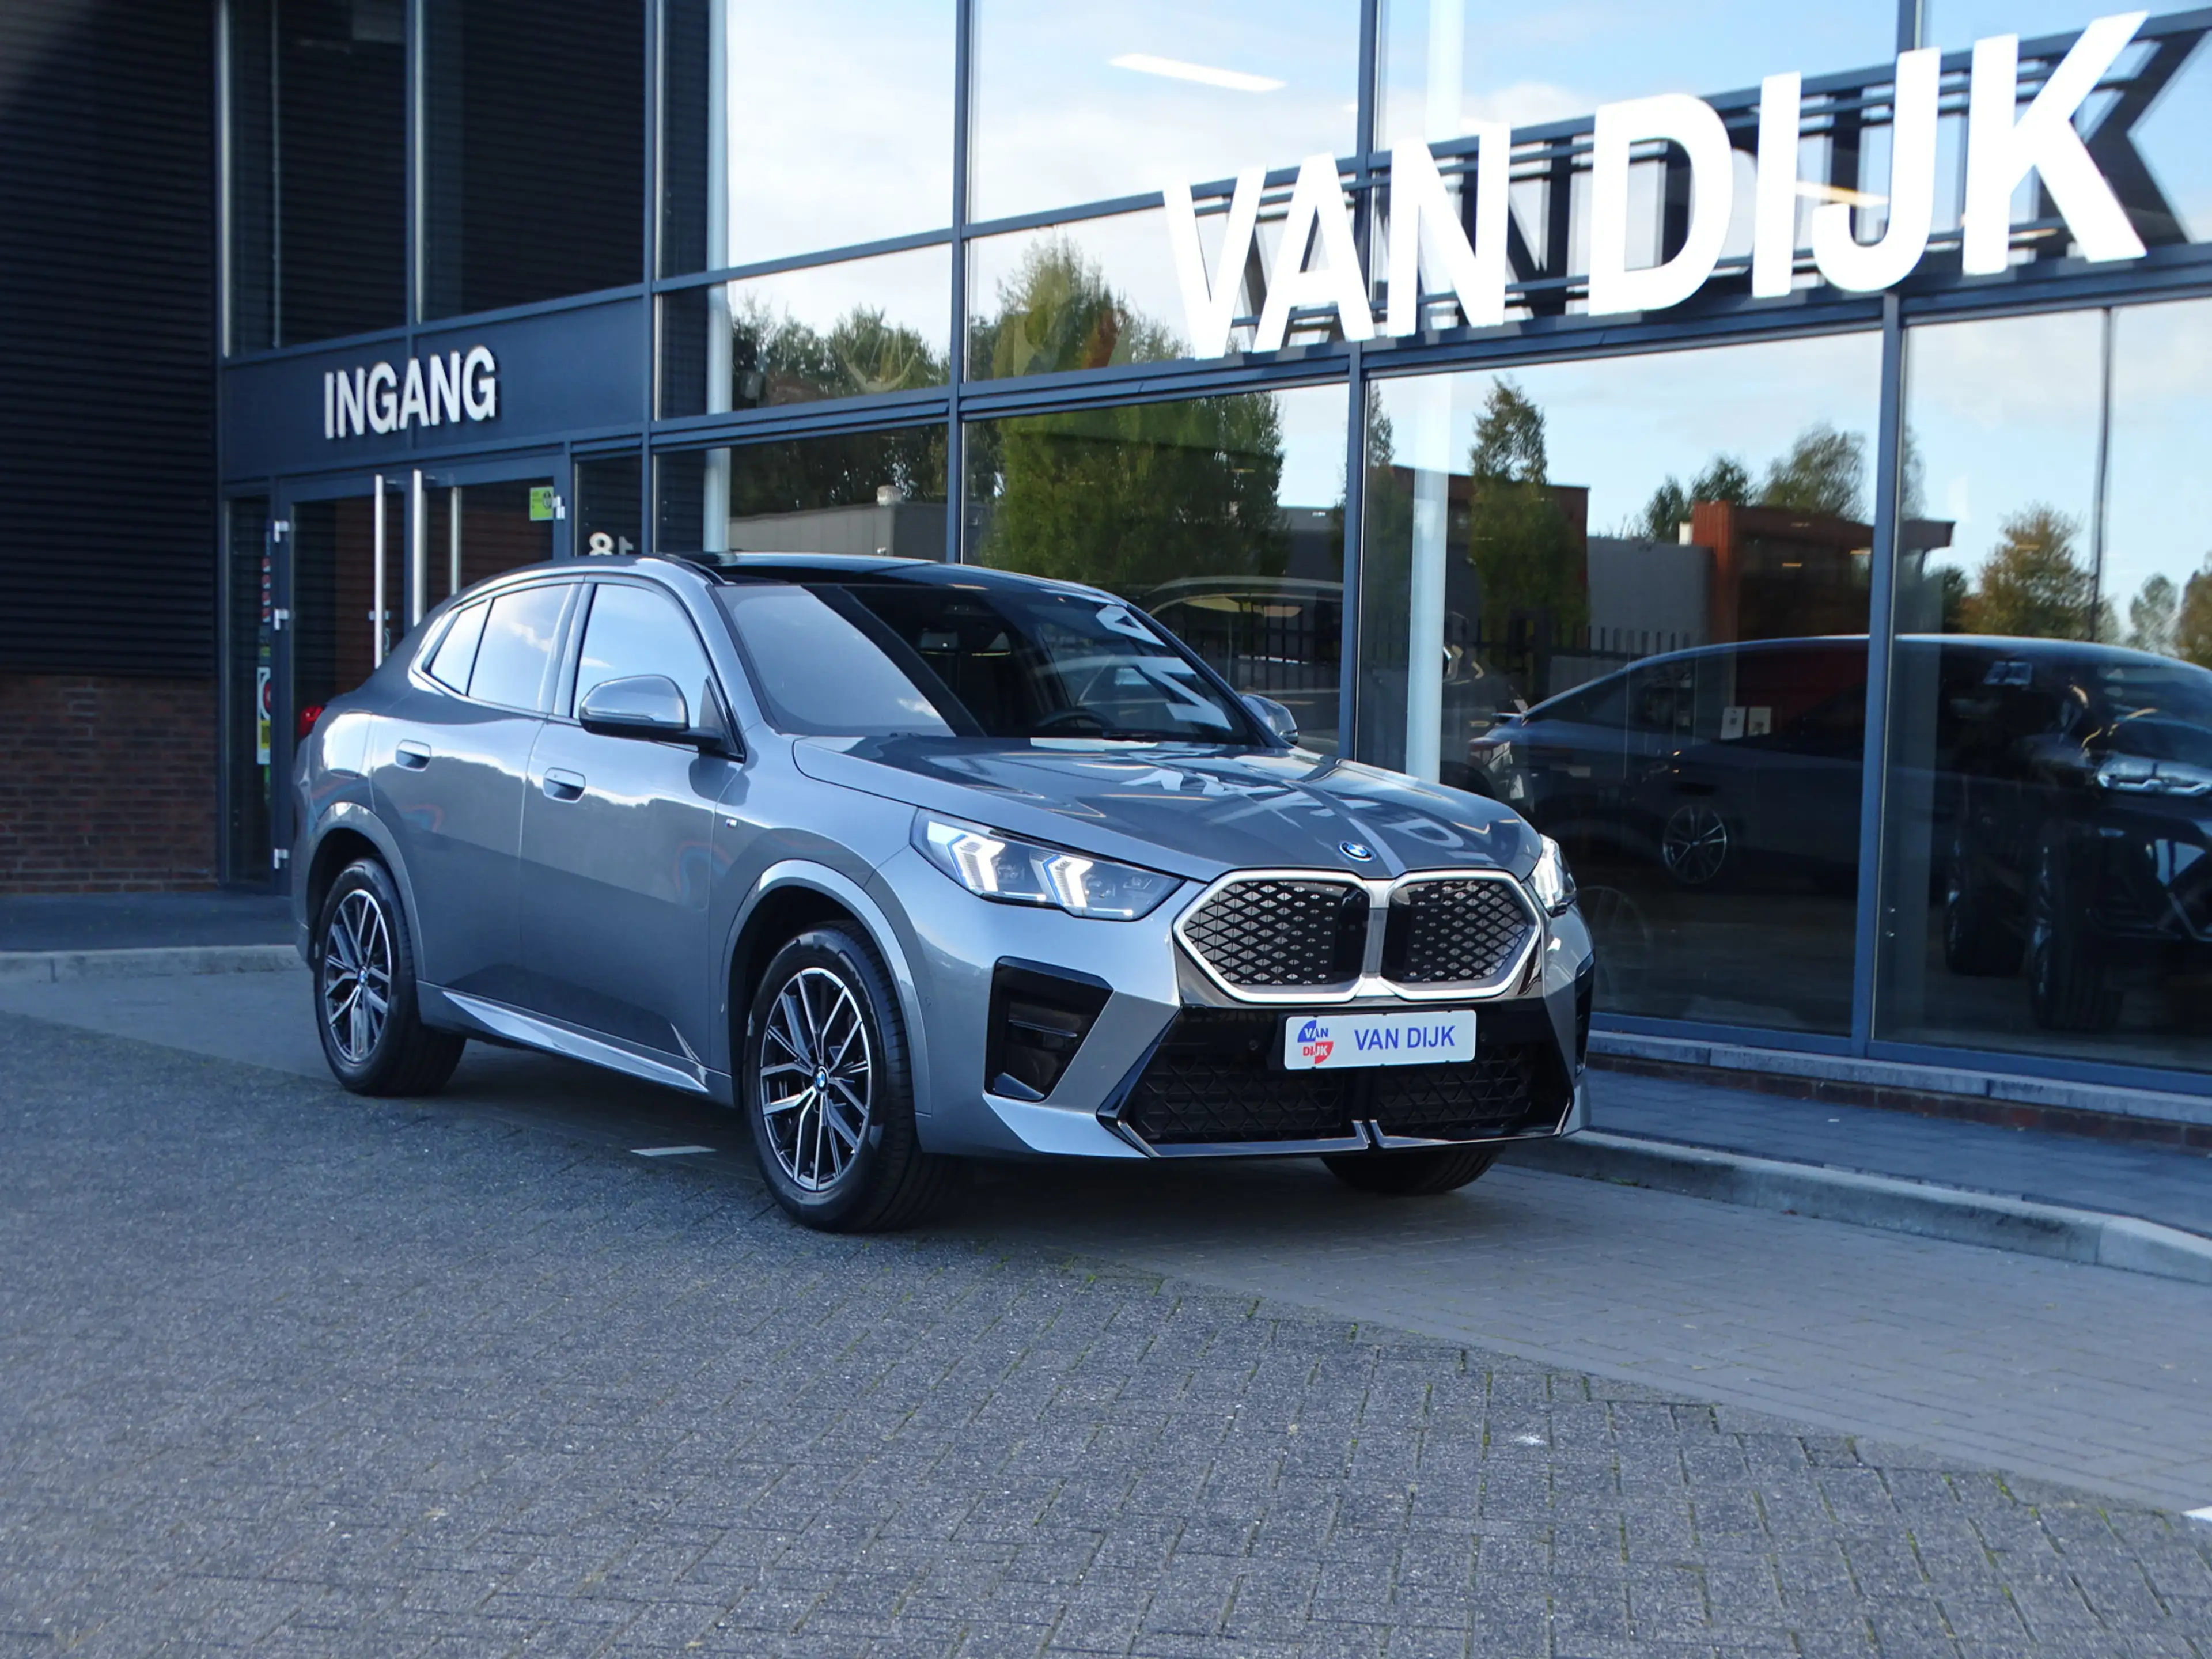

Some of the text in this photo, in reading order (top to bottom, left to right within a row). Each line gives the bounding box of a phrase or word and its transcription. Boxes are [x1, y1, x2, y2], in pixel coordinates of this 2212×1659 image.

[1162, 11, 2149, 361] VAN DIJK
[324, 346, 495, 439] INGANG
[1304, 1027, 1329, 1039] VAN
[1354, 1025, 1455, 1050] VAN DIJK
[1302, 1044, 1328, 1056] DIJK
